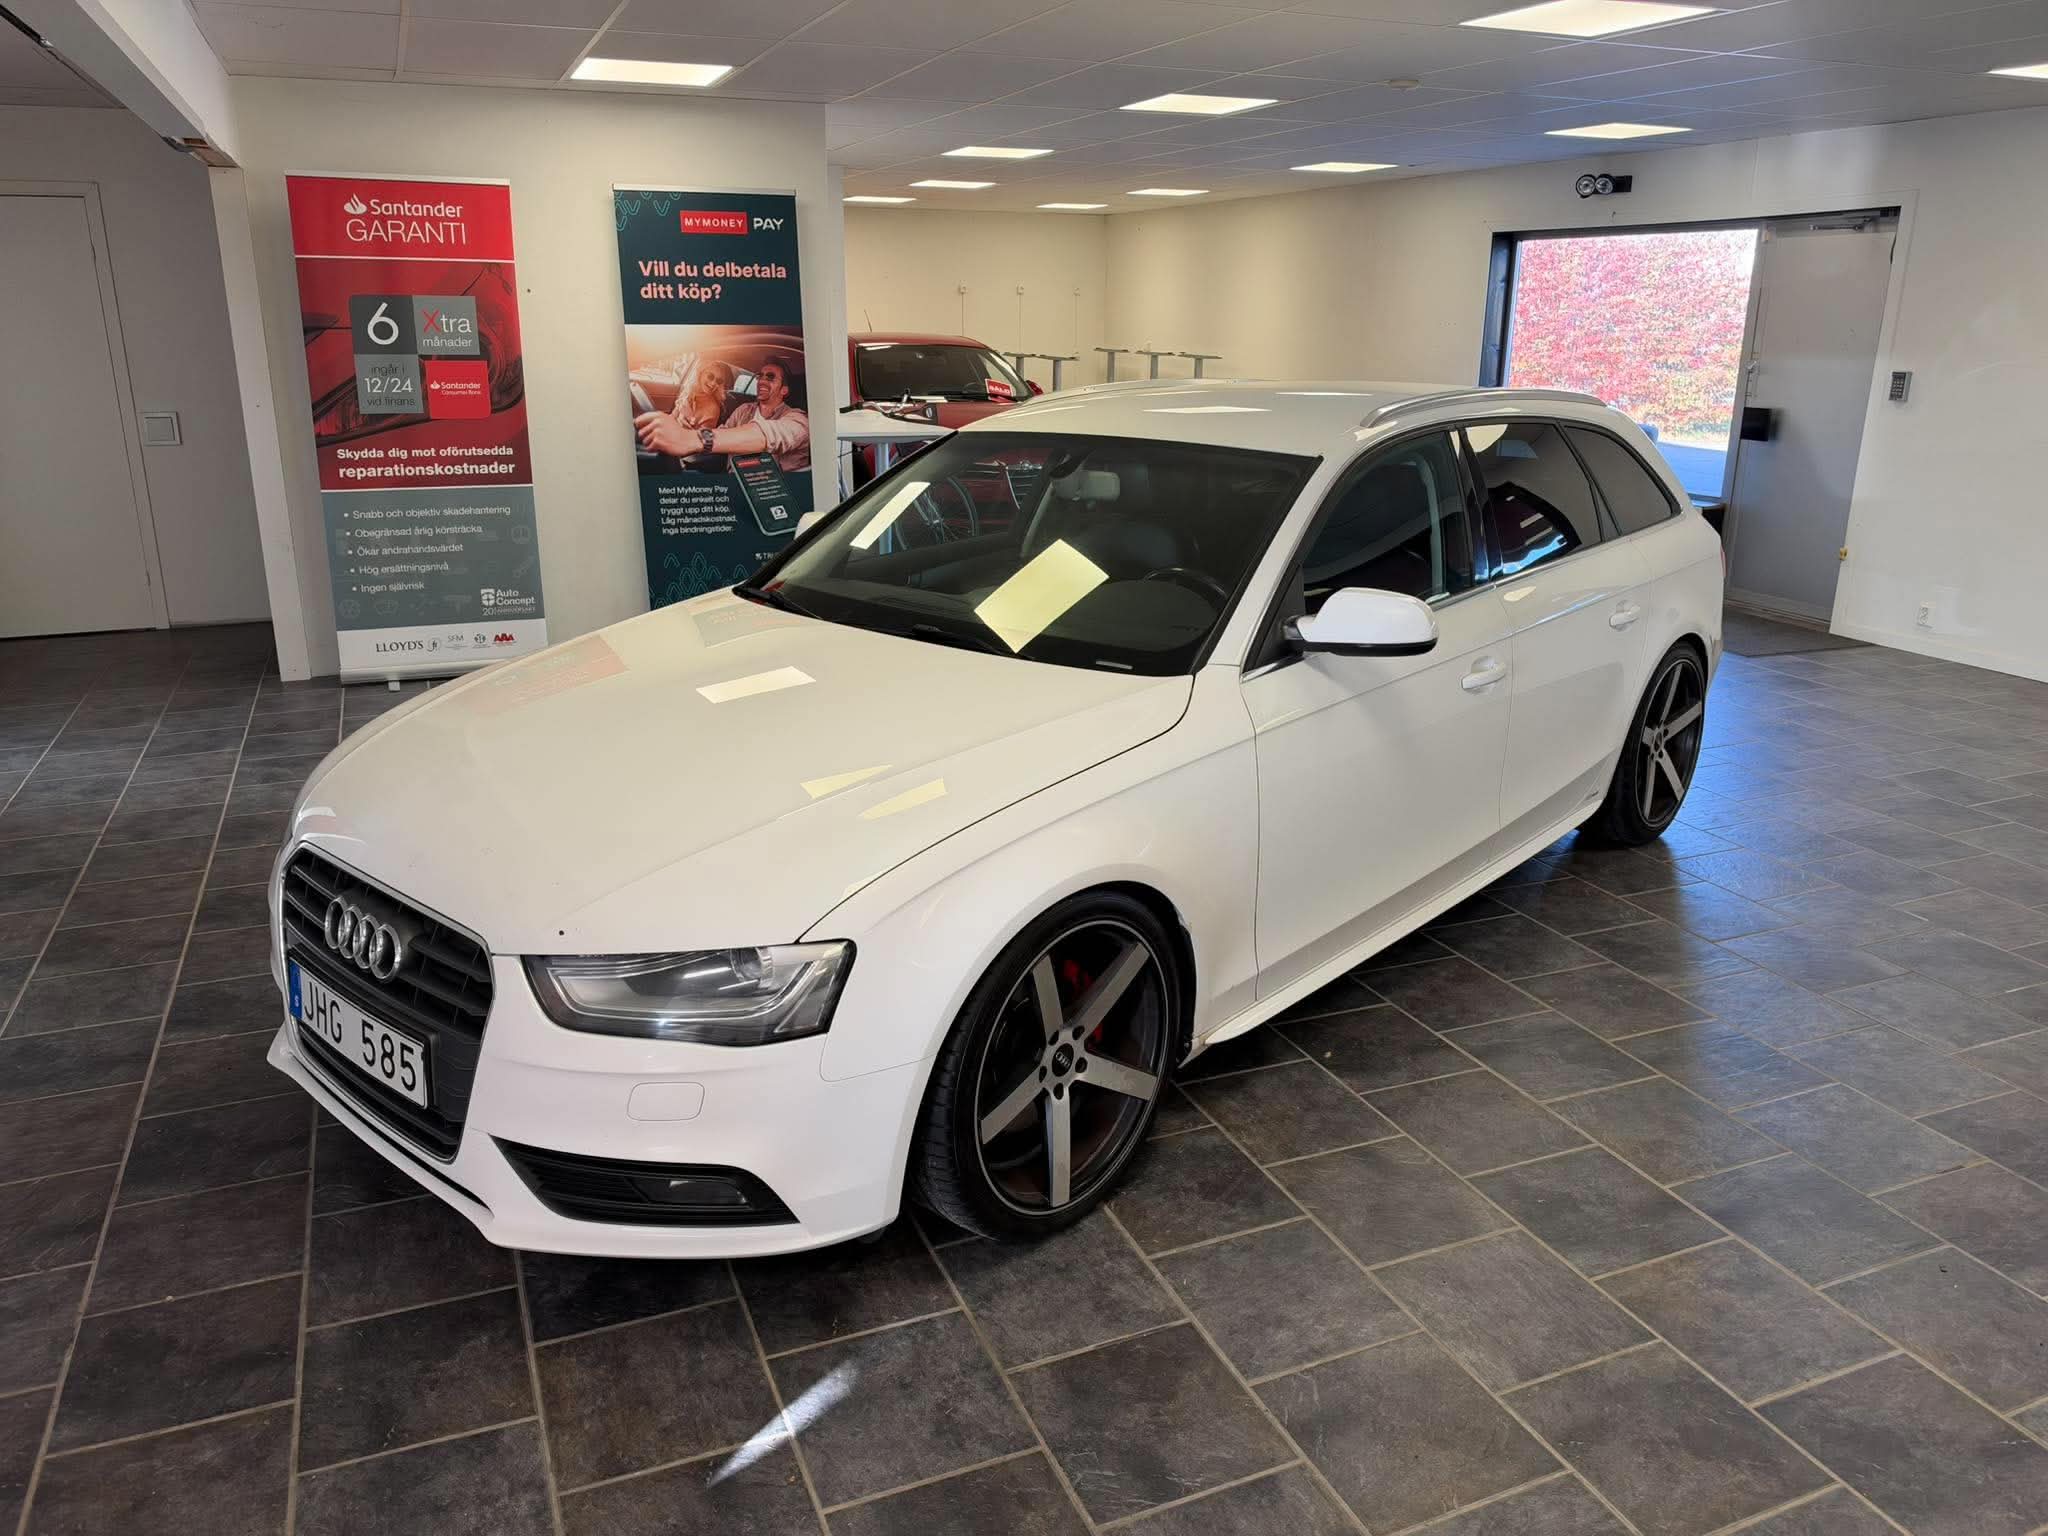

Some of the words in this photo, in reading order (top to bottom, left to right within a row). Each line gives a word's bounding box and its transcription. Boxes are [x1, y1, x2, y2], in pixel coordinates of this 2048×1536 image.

[370, 199, 463, 218] Santander
[684, 217, 744, 228] MYMONEY
[753, 217, 784, 230] PAY
[346, 219, 467, 244] GARANTI
[638, 261, 670, 277] Vill
[674, 262, 698, 277] du
[703, 262, 787, 278] delbetala
[640, 283, 674, 299] ditt
[678, 283, 722, 302] köp?
[367, 302, 399, 346] 6
[422, 308, 472, 333] Xtra
[422, 335, 472, 349] månader
[371, 364, 398, 376] ingår
[364, 377, 413, 393] 12/24
[441, 381, 481, 390] Santander
[367, 397, 380, 407] vid
[383, 397, 416, 406] finans
[337, 448, 384, 461] Skydda
[388, 447, 407, 459] dig
[412, 447, 435, 457] mot
[440, 445, 513, 457] oförutsedda
[339, 462, 515, 480] reparationskostnader
[677, 486, 713, 495] MyMoney
[714, 485, 728, 494] Pay
[353, 510, 384, 519] Snabb
[386, 509, 403, 518] och
[406, 507, 440, 518] objektiv
[443, 506, 511, 516] skadehantering
[660, 507, 684, 516] tryggt
[661, 516, 676, 525] Låg
[354, 527, 412, 539] Obegränsad
[414, 526, 433, 537] årlig
[662, 527, 679, 535] Inga
[357, 546, 380, 556] Ökar
[381, 543, 464, 555] andrahandsvärdet
[359, 565, 379, 576] Hög
[380, 562, 449, 573] ersättningsnivå
[360, 583, 387, 594] Ingen
[388, 581, 425, 592] självrisk
[496, 589, 519, 597] Auto
[496, 596, 536, 606] Concept
[375, 640, 424, 653] LLOYD'S
[304, 981, 342, 1044] JHG
[361, 1019, 416, 1091] 585
